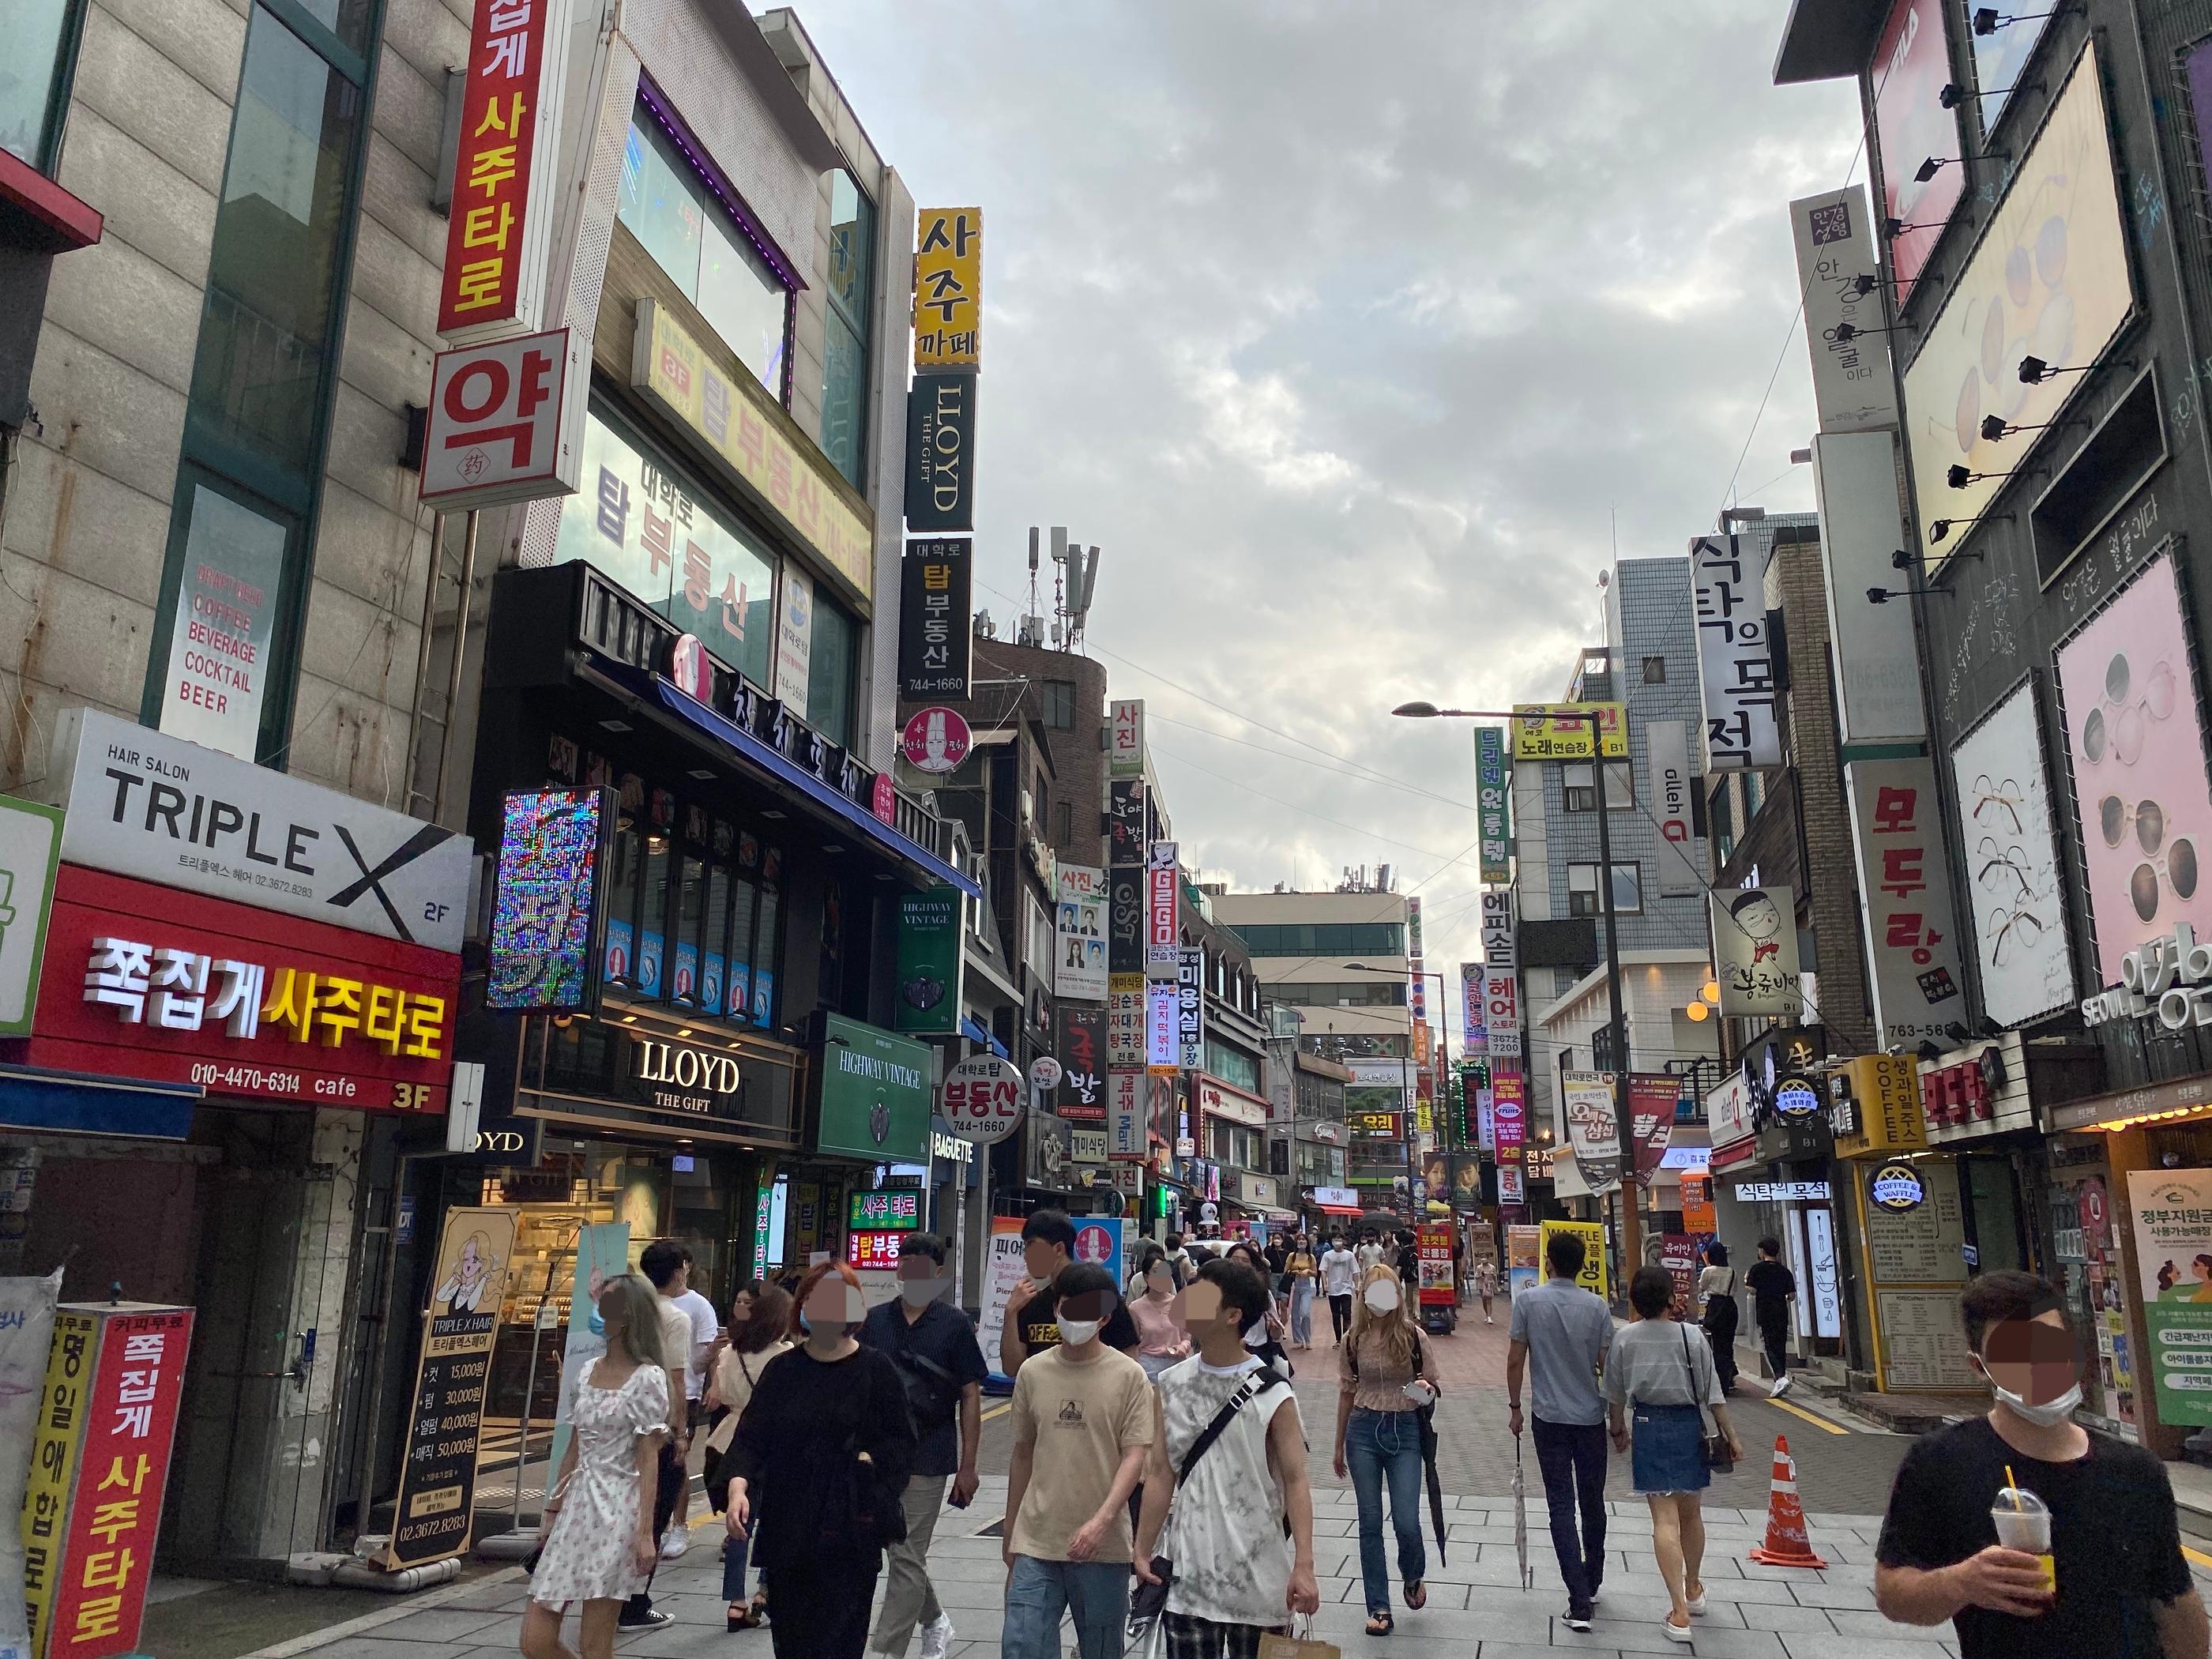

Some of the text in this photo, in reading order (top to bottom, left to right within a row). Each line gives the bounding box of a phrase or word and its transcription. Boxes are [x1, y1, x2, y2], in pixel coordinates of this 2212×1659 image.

[444, 349, 551, 469] 약
[921, 412, 932, 483] THE GIFT
[935, 384, 963, 513] LLOYD
[916, 544, 961, 558] 대학로
[640, 504, 750, 645] 부동산
[923, 563, 951, 590] 탑
[194, 592, 252, 633] COFFEE
[188, 620, 257, 664] BEVERAGE
[922, 594, 951, 670] 부동산
[184, 650, 252, 694] COCKTAIL
[908, 678, 964, 691] 744-1660
[179, 680, 228, 715] BEER
[1115, 705, 1138, 749] 사진
[1610, 743, 1624, 752] B1
[107, 743, 190, 782] HAIR SALON
[105, 767, 457, 944] TRIPLE X
[254, 874, 313, 898] 02.3672.8283
[1061, 870, 1092, 893] 사진
[423, 901, 450, 924] 2F
[903, 902, 952, 912] HIGHWAY
[904, 914, 950, 924] VINTAGE
[1483, 893, 1514, 969] 에피소드
[1150, 952, 1177, 961] 연습장
[1110, 976, 1144, 989] 개미식당
[83, 936, 446, 1059] 쪽집게 사주타로
[1179, 965, 1200, 1033] 미용실
[1488, 976, 1516, 1019] 헤어
[1157, 999, 1170, 1057] 김치떡볶이
[1179, 1033, 1198, 1043] 1층
[1490, 1020, 1517, 1029] 스토리
[1492, 1034, 1518, 1044] 3672
[1492, 1044, 1518, 1052] 7200
[639, 1040, 740, 1096] LLOYD
[840, 1049, 921, 1089] HIGHWAY VINTAGE
[1116, 1051, 1136, 1062] 전문
[190, 1062, 431, 1109] 010-4470-6314 cafe 3F
[944, 1081, 1019, 1117] 부동산
[1118, 1075, 1134, 1112] 맥주
[654, 1091, 711, 1114] THE GIFT
[1876, 1061, 1898, 1143] COFFEE
[1894, 1060, 1919, 1142] 생과일주스
[954, 1120, 1006, 1133] 744-1660
[1118, 1115, 1131, 1152] Mart
[935, 1135, 973, 1164] BAGUETTE
[1501, 1146, 1520, 1159] 2층
[1740, 1183, 1827, 1201] 식탁의 목적
[860, 1194, 889, 1220] 사주
[890, 1194, 917, 1219] 타로
[860, 1236, 873, 1258] 탑
[872, 1234, 907, 1259] 부동
[1664, 1243, 1691, 1256] 육미안
[114, 1314, 185, 1333] 커피무료
[434, 1316, 494, 1334] TRIPLE X HAIR
[2165, 1332, 2212, 1342] 긴급재난지
[428, 1360, 486, 1383] 컷 15,000원
[424, 1386, 483, 1409] 펌 30,000원
[419, 1410, 480, 1436] 열펌 40,000원
[415, 1435, 476, 1462] 매직 50,000원
[70, 1333, 165, 1644] 쪽집게 사주타로
[399, 1514, 467, 1542] 02.3672.8283
